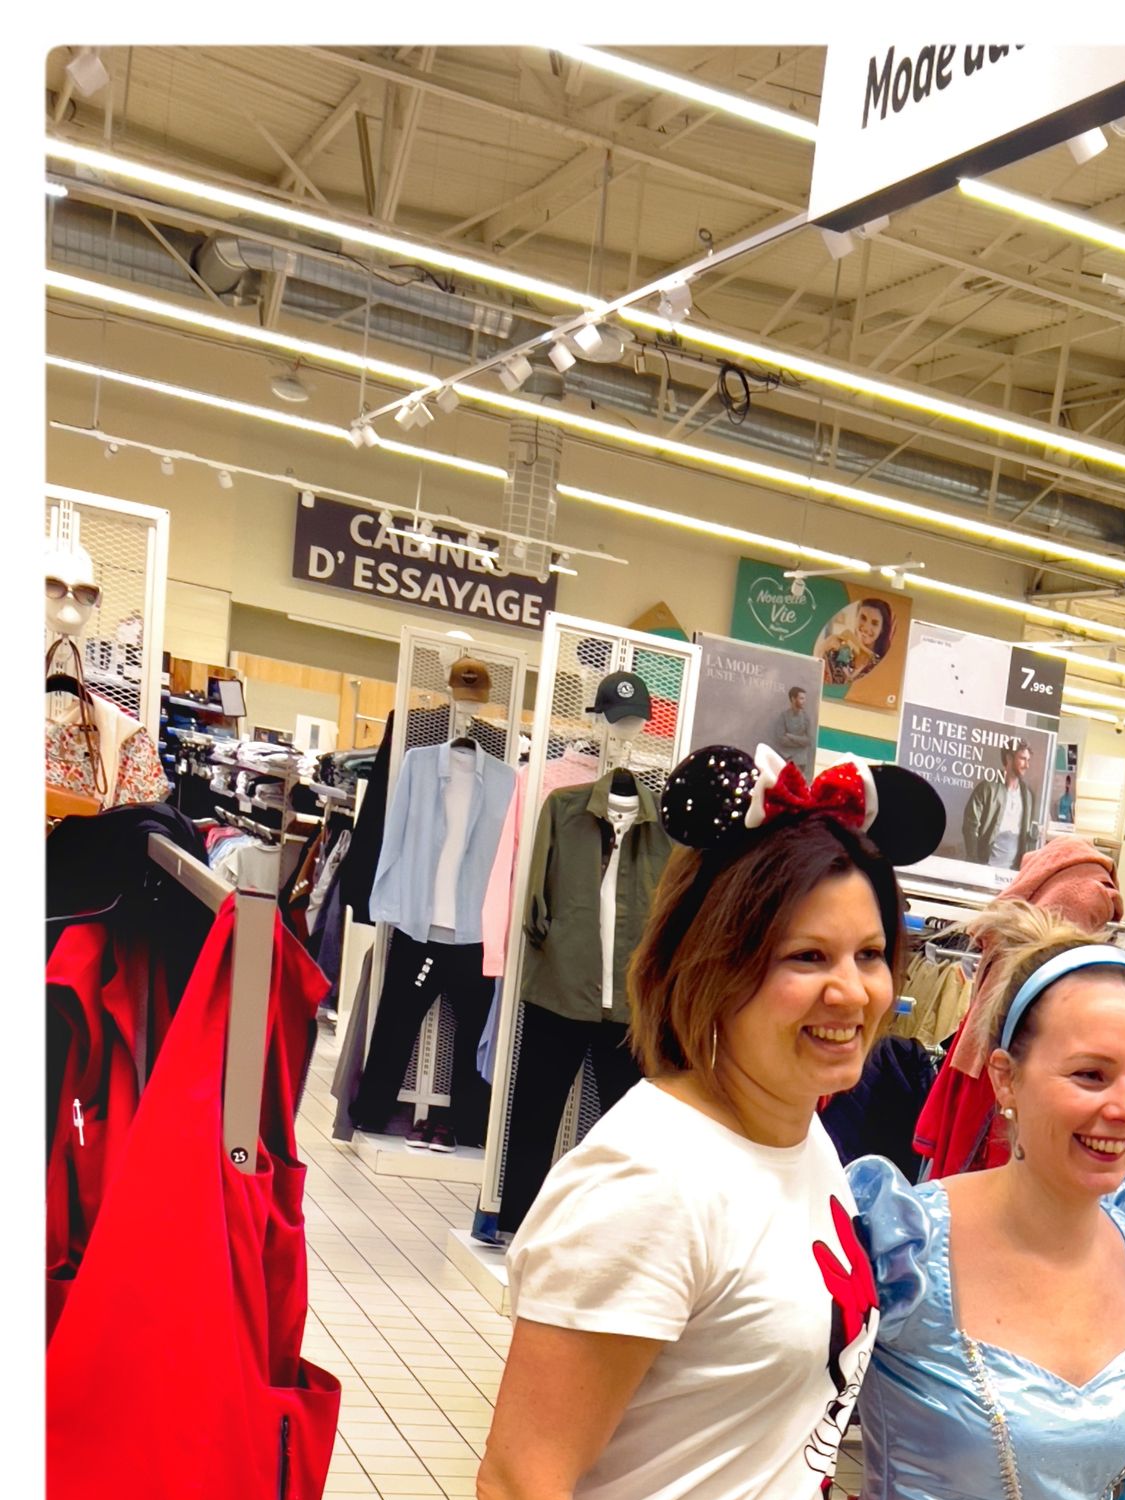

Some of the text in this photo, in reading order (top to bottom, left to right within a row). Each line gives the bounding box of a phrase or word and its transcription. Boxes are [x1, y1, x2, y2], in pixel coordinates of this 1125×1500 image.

[353, 555, 543, 626] ESSAYAGE
[770, 604, 798, 624] Vie
[725, 657, 764, 677] MODE
[909, 732, 985, 763] TUNISIEN
[911, 714, 1022, 752] LE TEE SHIRT
[908, 751, 1008, 786] 100% COTON
[232, 1151, 246, 1163] 25
